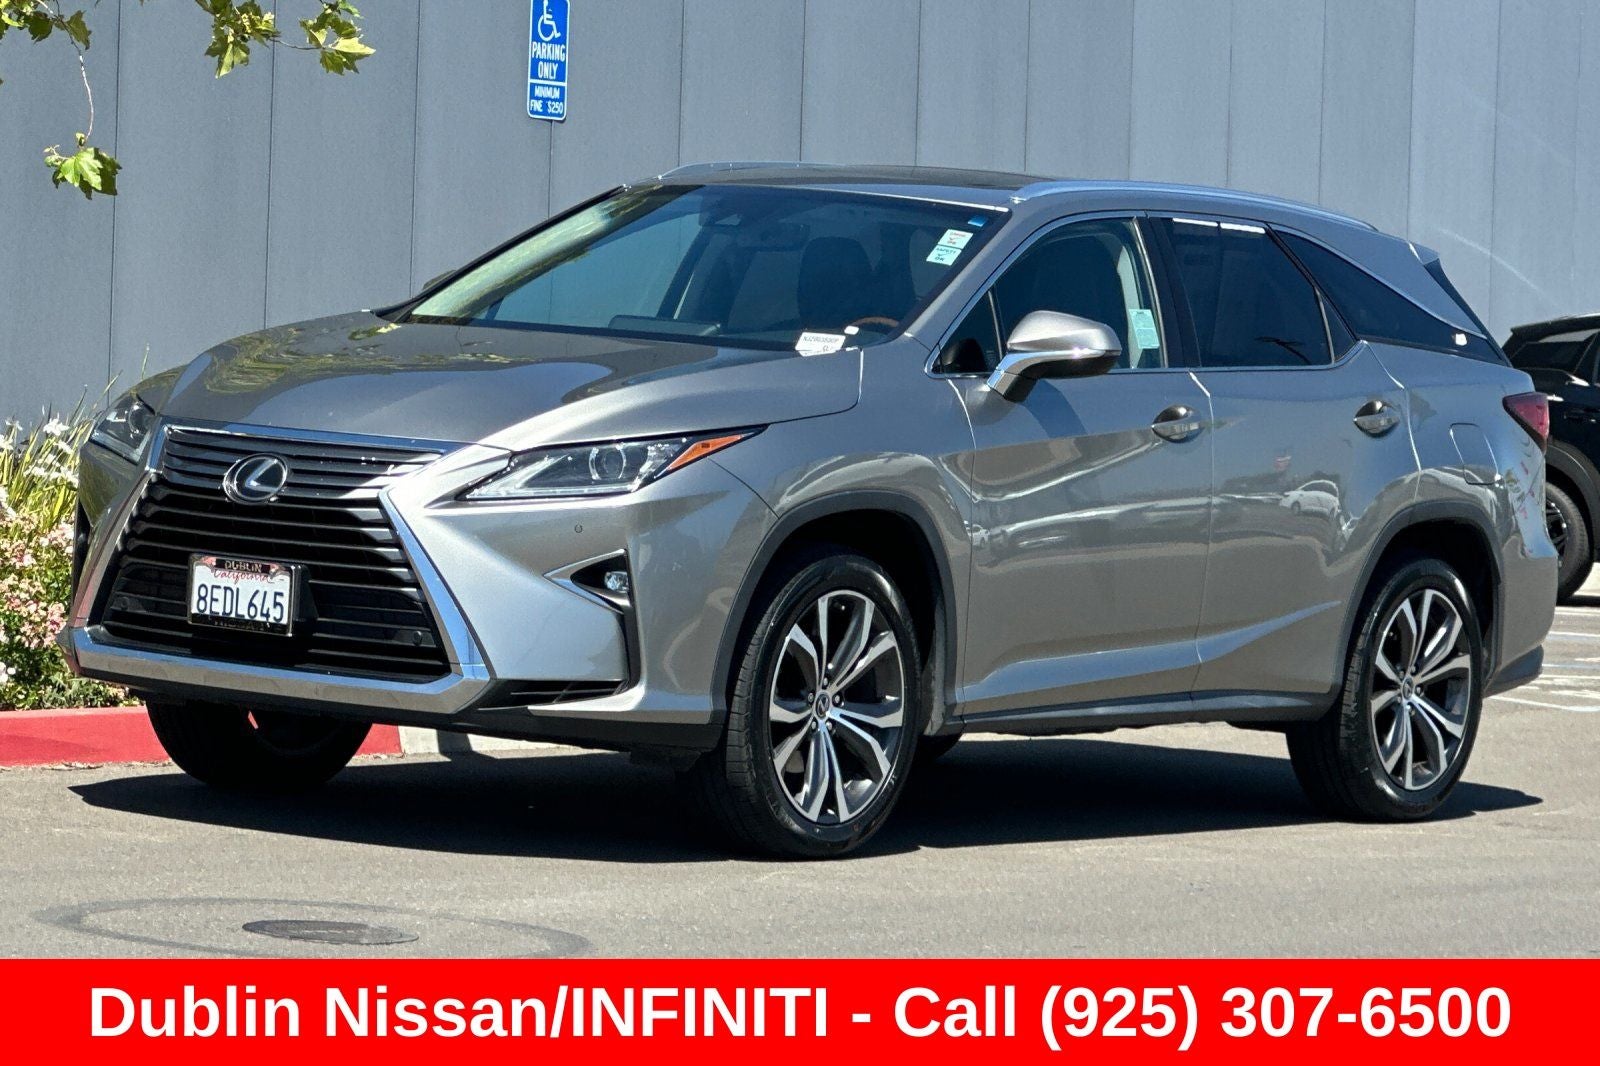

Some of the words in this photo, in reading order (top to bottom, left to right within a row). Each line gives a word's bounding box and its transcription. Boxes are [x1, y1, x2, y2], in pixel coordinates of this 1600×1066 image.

[531, 41, 566, 62] PARKING
[537, 61, 559, 80] ONLY
[534, 85, 560, 99] MINIMUM
[530, 99, 543, 112] FINE
[547, 101, 564, 115] $250
[224, 560, 263, 574] DUBLIN
[196, 583, 285, 623] 8EDL645
